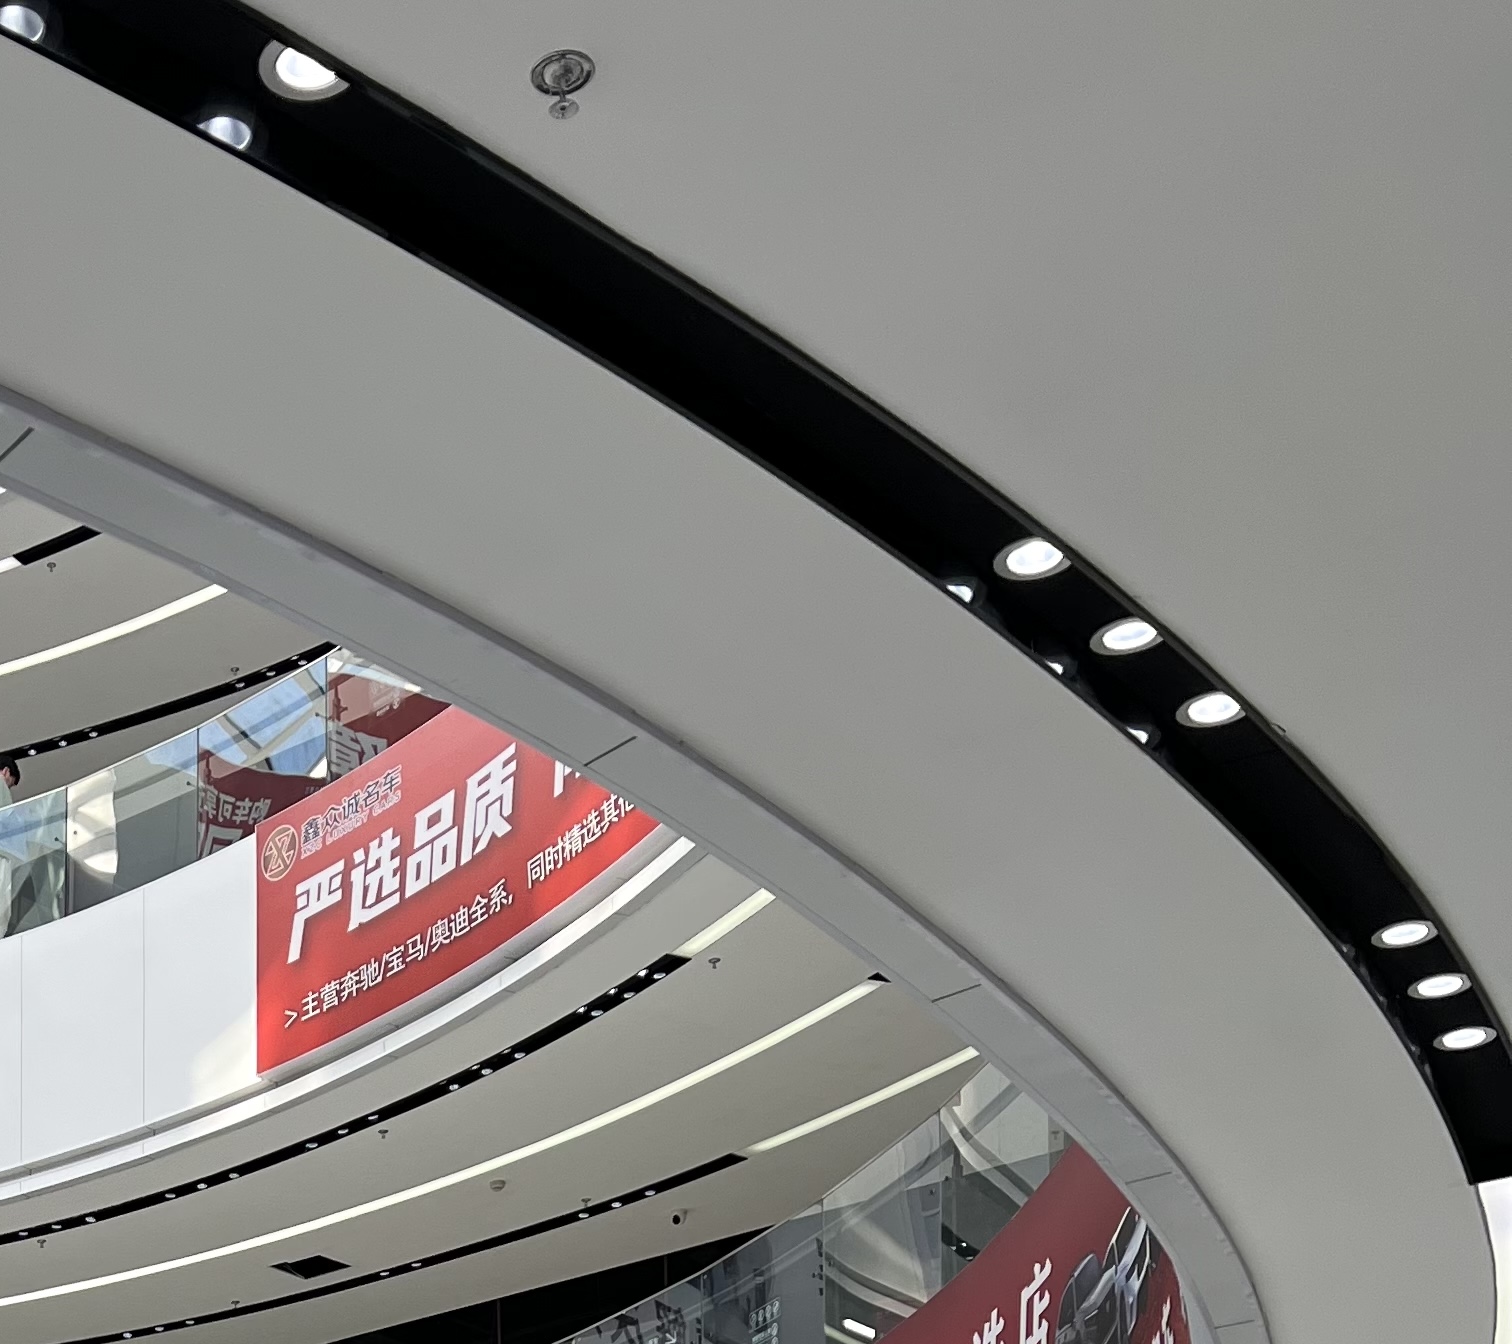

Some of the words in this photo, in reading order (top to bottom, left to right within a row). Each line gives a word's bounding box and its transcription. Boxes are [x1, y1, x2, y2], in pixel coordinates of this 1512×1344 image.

[286, 742, 518, 964] 严选品质
[301, 764, 403, 843] 鑫众诚名车
